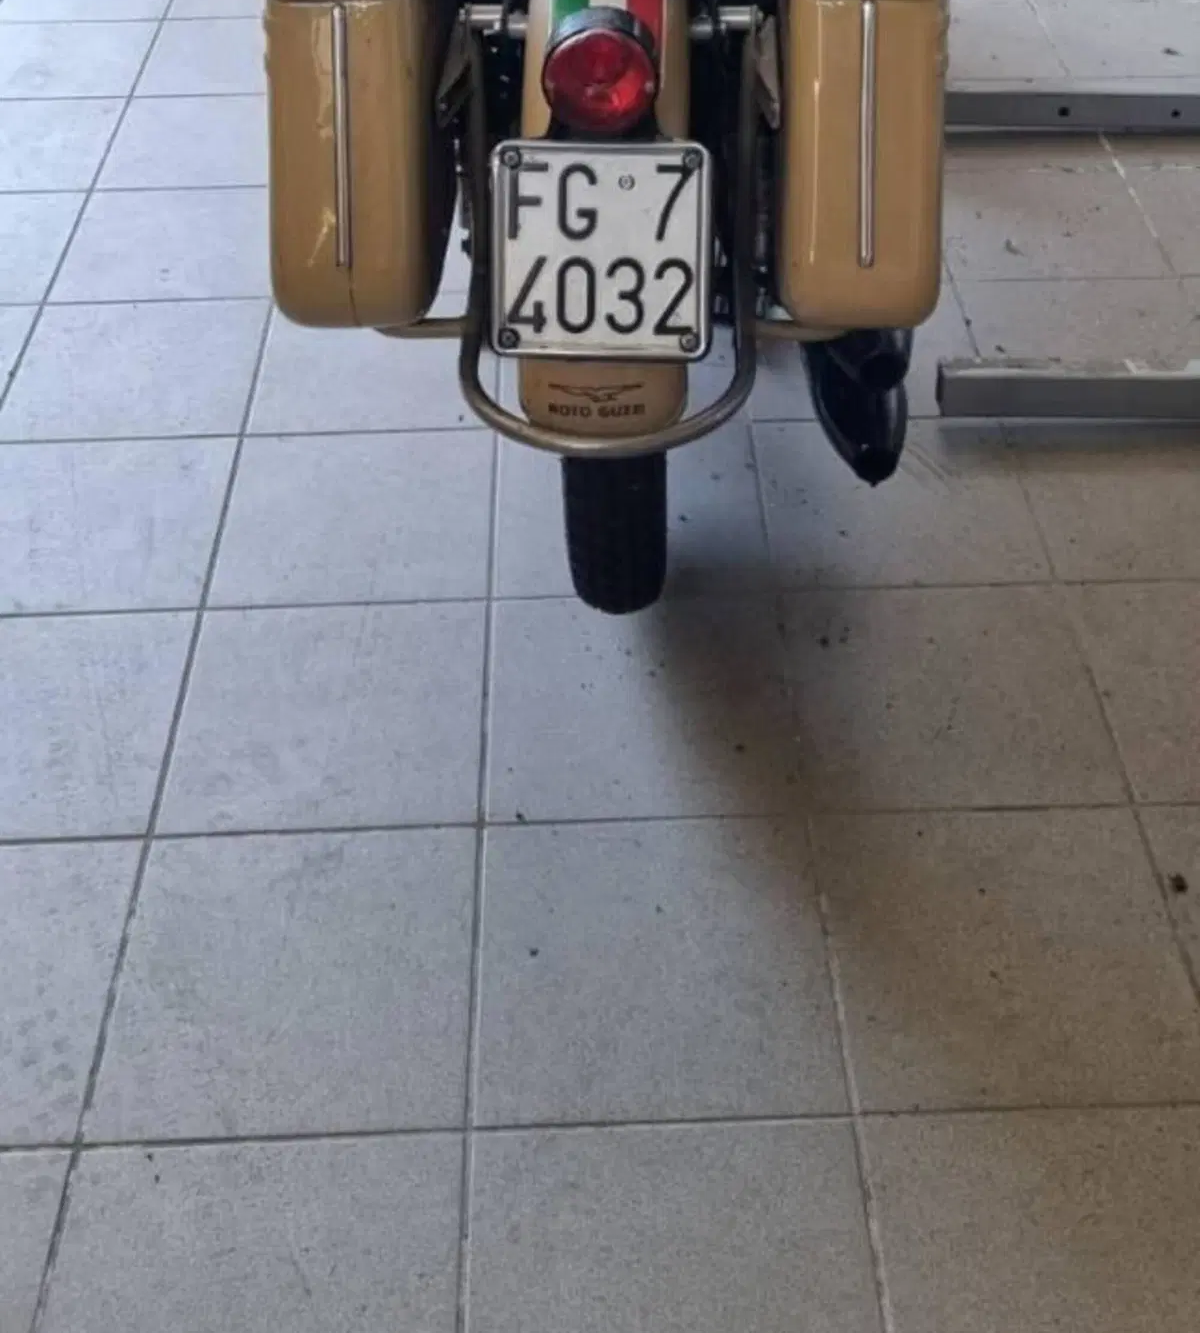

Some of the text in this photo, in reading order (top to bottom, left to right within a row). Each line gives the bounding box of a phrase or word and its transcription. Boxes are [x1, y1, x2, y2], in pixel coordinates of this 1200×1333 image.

[508, 163, 700, 241] FG 7
[505, 255, 694, 336] 4032
